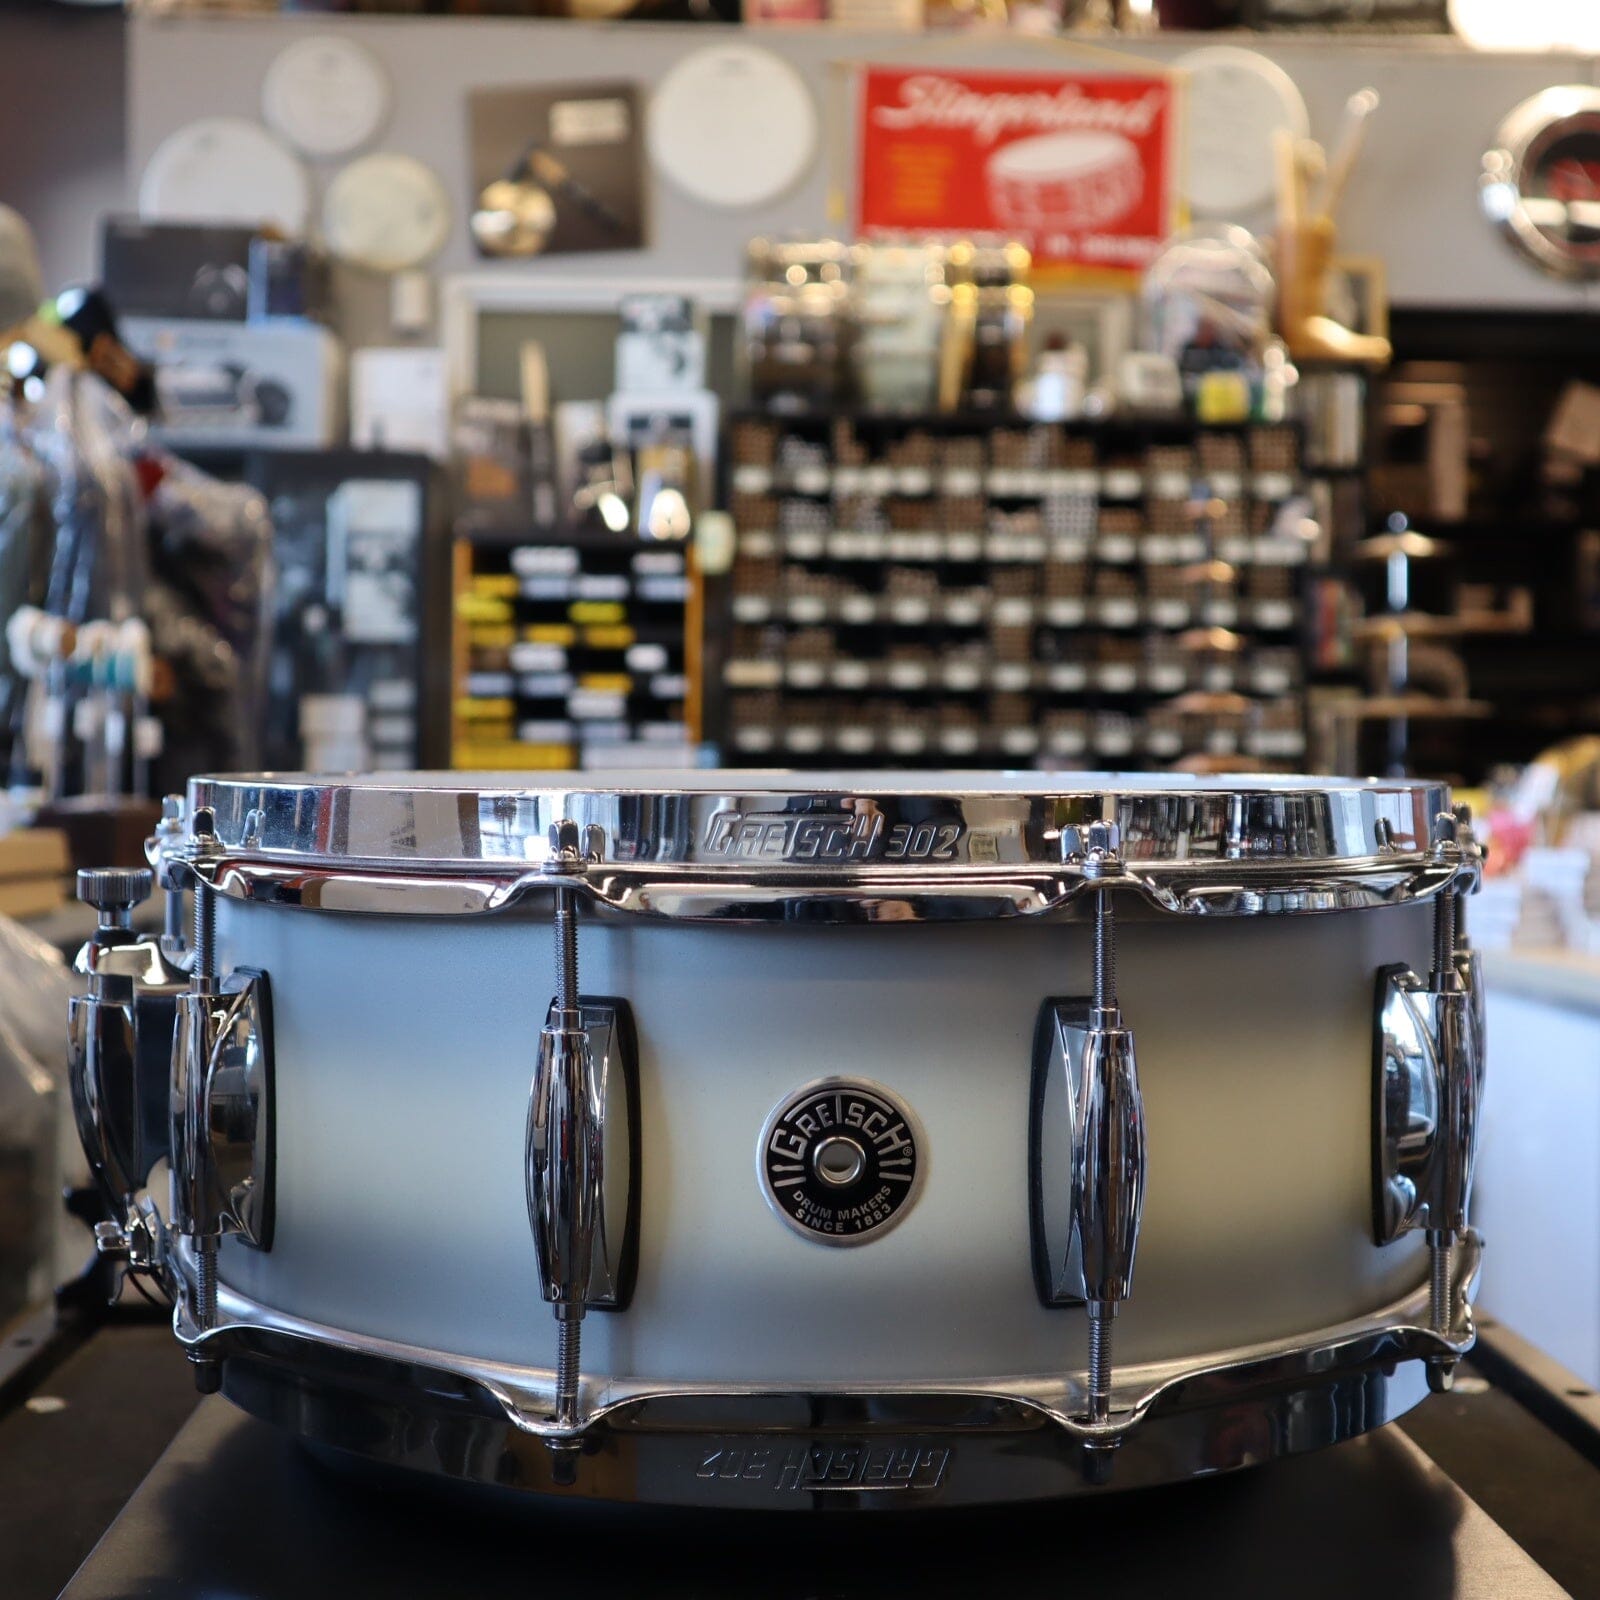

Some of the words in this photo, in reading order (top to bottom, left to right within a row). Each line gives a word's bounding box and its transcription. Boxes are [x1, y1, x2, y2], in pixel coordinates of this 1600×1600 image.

[704, 812, 884, 857] GRETSCH
[885, 825, 960, 858] 302
[792, 1190, 832, 1219] DRUM
[837, 1185, 891, 1220] MAKERS
[795, 1208, 844, 1232] SINCE
[855, 1203, 892, 1229] 1883
[773, 1447, 953, 1490] GRETSCH
